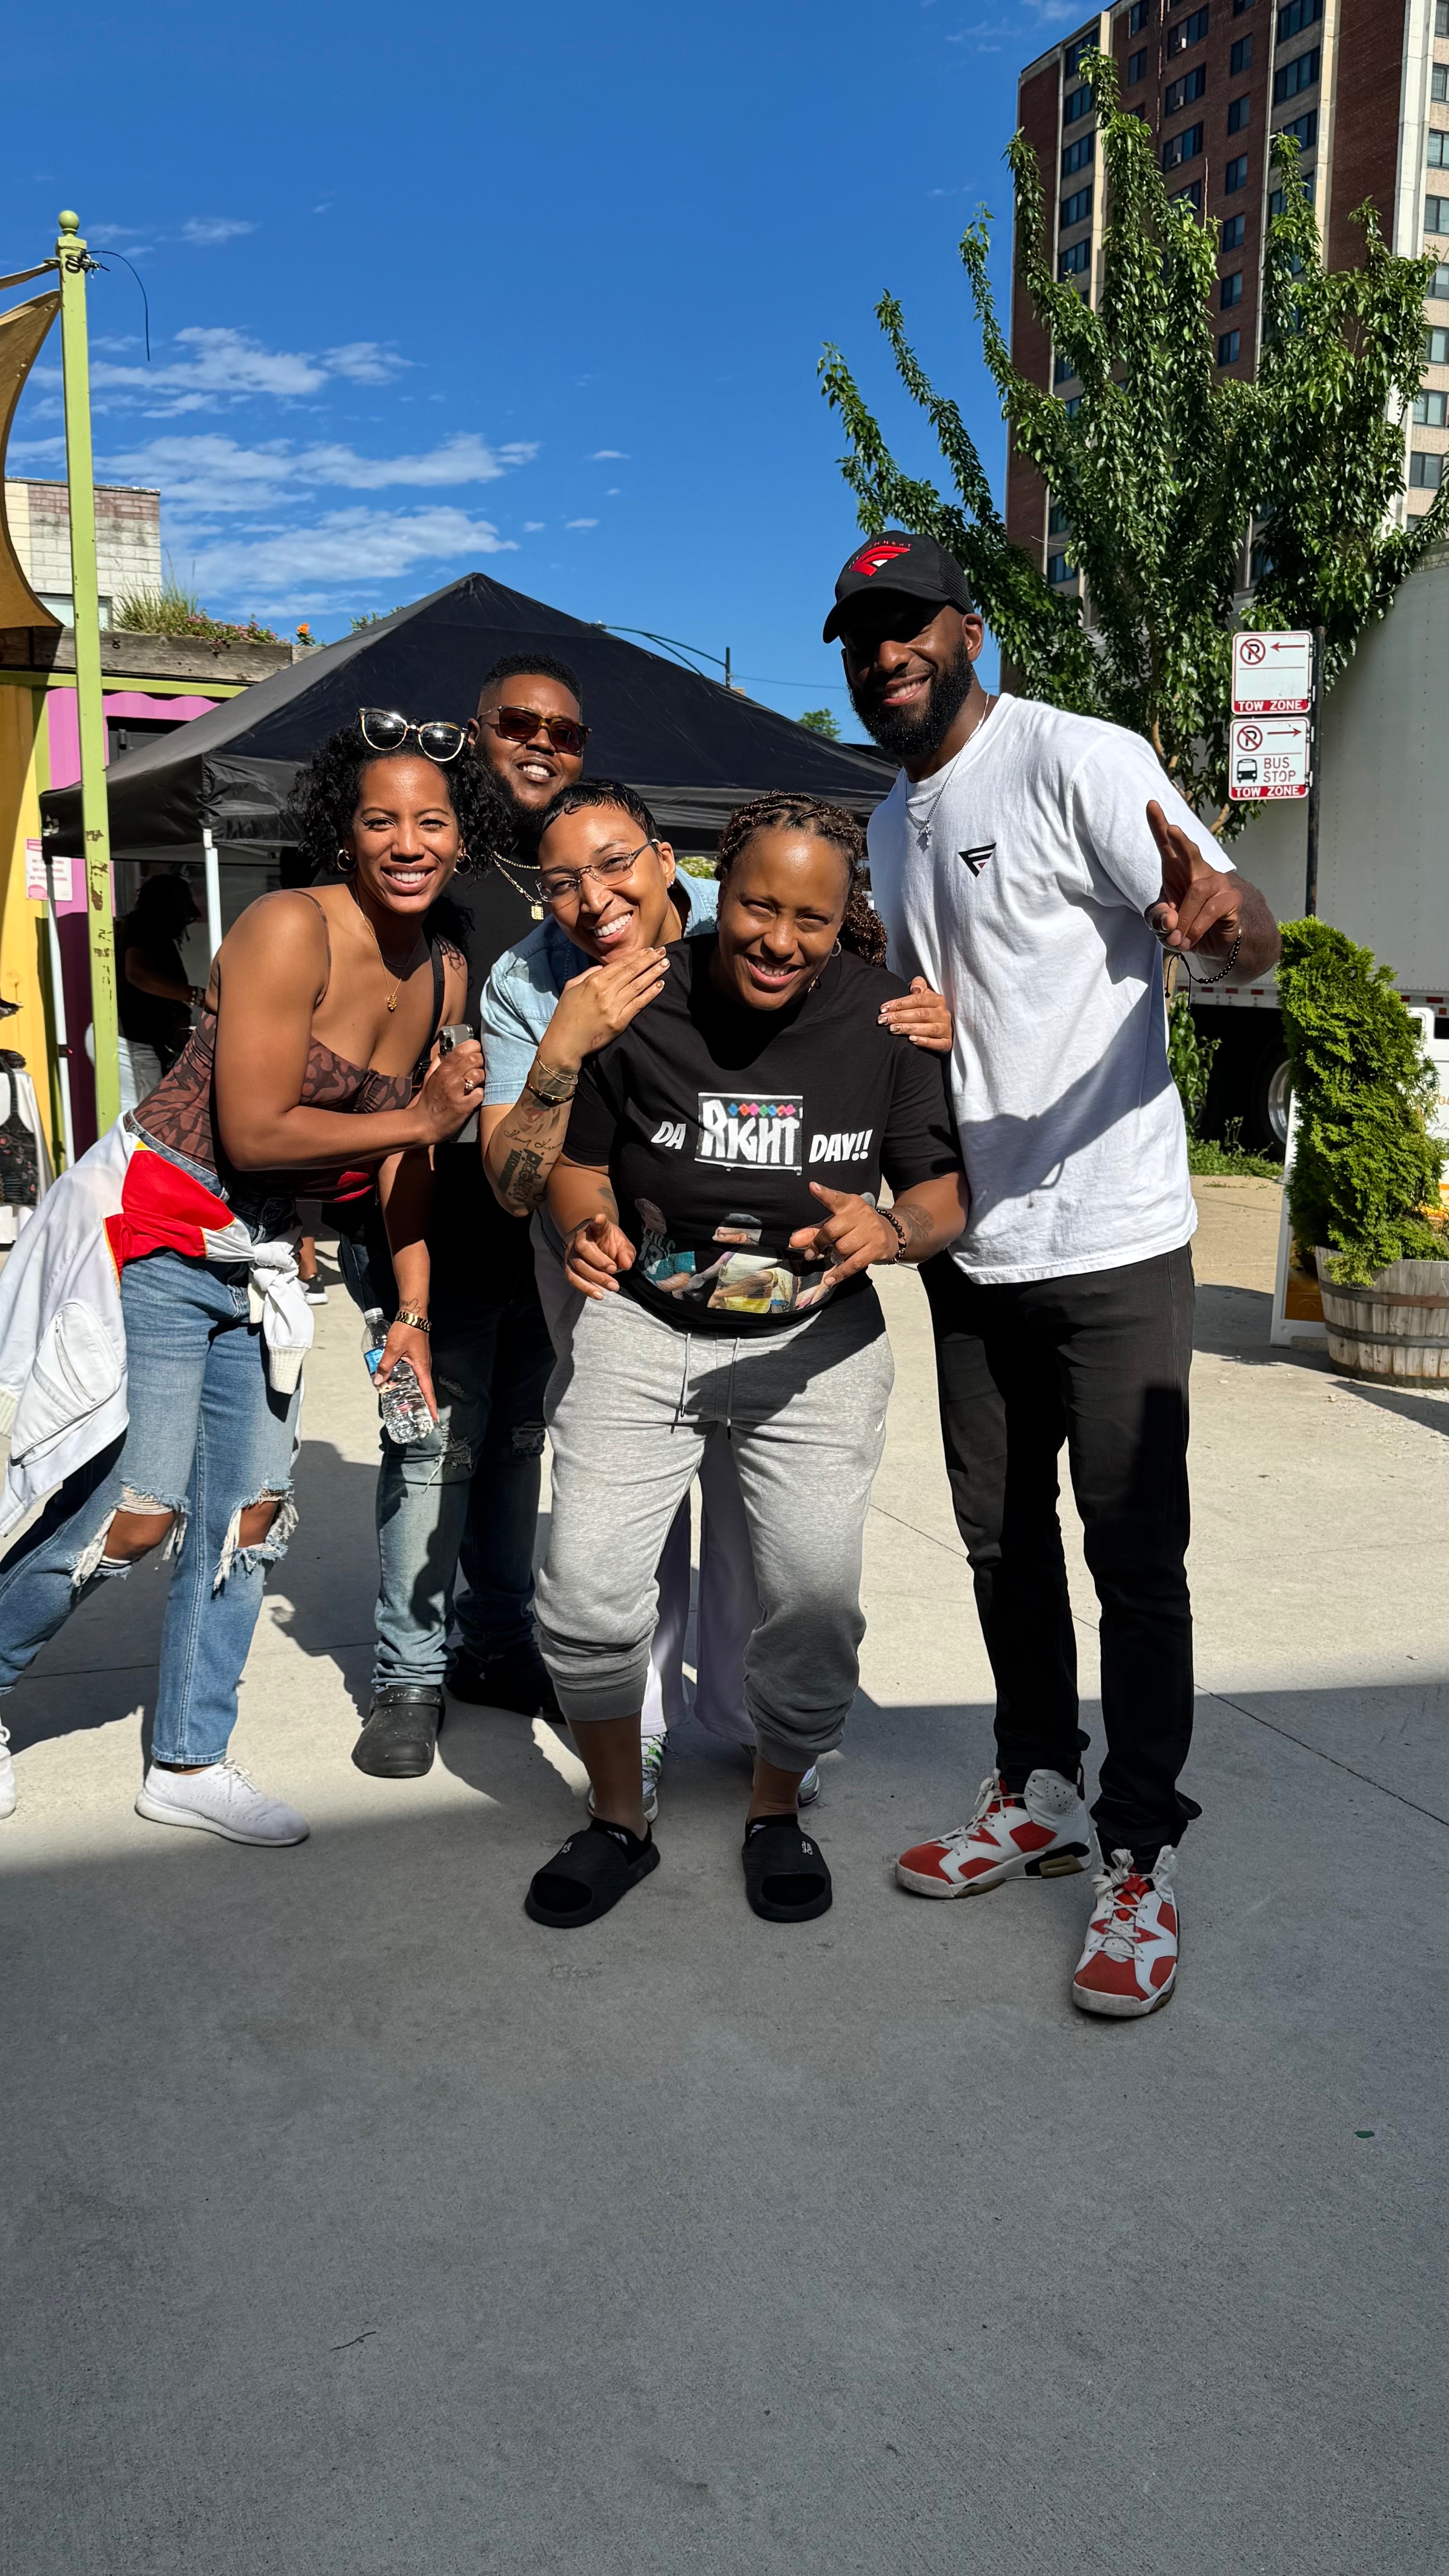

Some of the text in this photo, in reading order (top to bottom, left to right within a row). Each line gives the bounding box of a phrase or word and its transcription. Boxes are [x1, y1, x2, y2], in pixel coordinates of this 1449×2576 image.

[1238, 699, 1302, 711] TOW ZONE
[1264, 757, 1289, 769] BUS
[1263, 770, 1296, 782] STOP
[1235, 785, 1300, 797] TOW ZONE
[651, 1099, 873, 1165] DA RIGHT DAY!!
